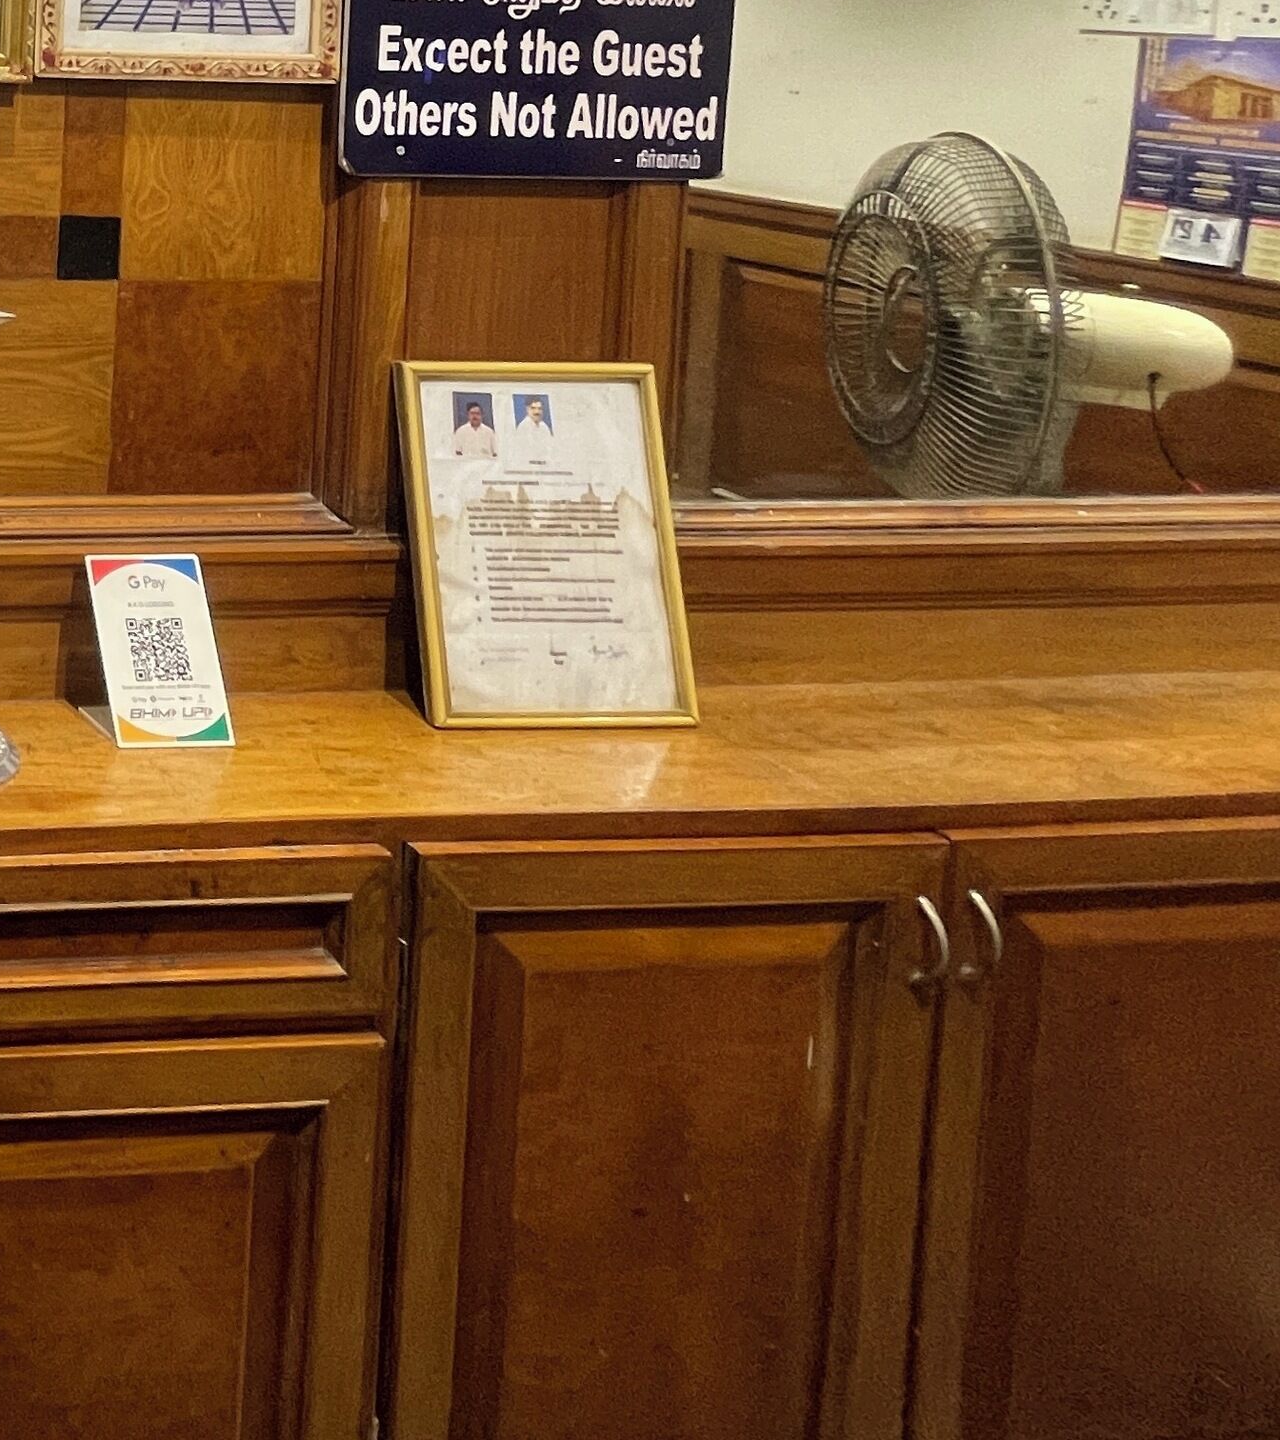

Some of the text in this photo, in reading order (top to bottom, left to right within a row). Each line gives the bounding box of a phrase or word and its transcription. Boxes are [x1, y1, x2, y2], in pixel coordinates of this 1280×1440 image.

[377, 24, 705, 79] Excect the Guest
[354, 87, 719, 142] Others Not Allowed
[142, 575, 166, 593] Pay
